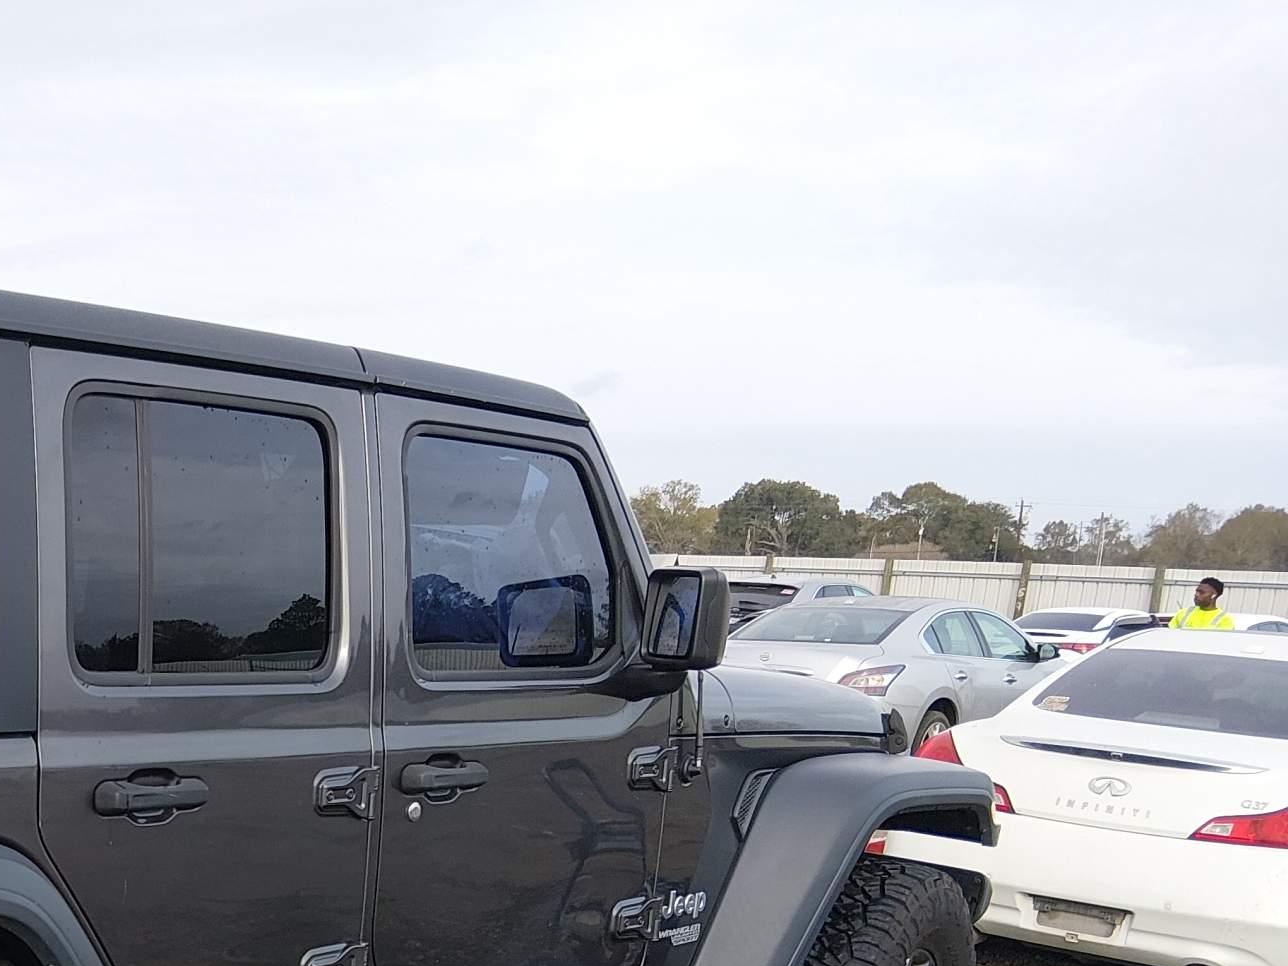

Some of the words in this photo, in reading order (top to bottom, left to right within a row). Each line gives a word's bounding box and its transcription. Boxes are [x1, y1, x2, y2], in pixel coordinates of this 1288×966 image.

[1055, 797, 1152, 819] INFINITI
[1240, 799, 1269, 811] G37
[662, 890, 706, 919] Jeep
[658, 923, 701, 939] WRANGLER
